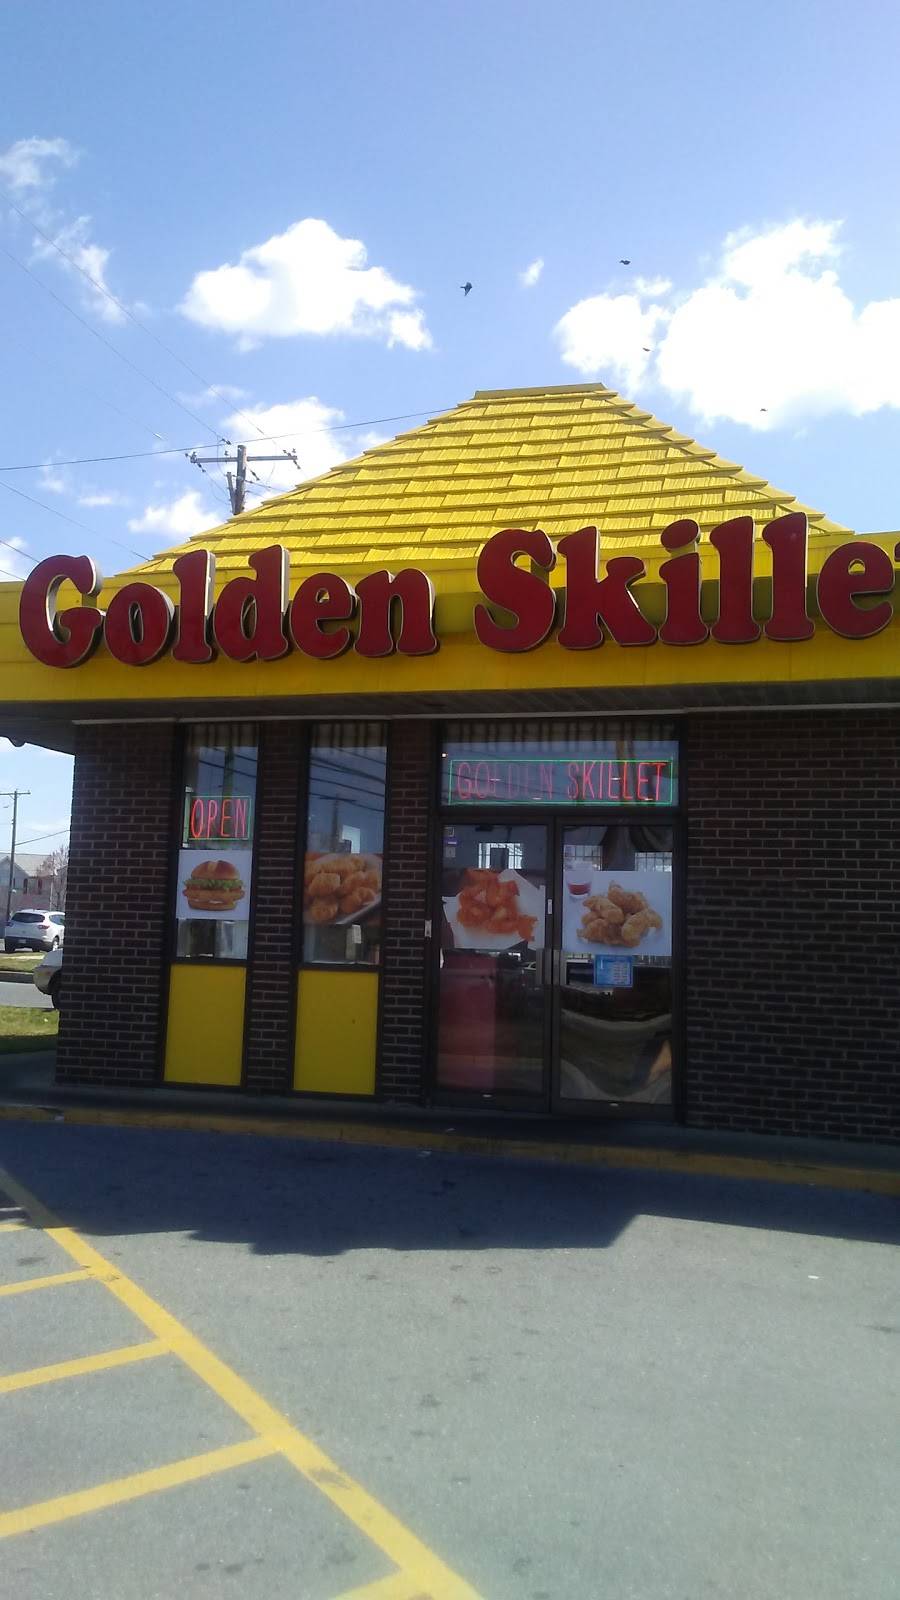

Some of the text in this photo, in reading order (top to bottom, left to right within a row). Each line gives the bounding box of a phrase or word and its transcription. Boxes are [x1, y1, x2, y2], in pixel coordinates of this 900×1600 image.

[19, 512, 900, 668] Golden Skille
[567, 761, 667, 801] SKILLET
[190, 798, 247, 838] OPEN
